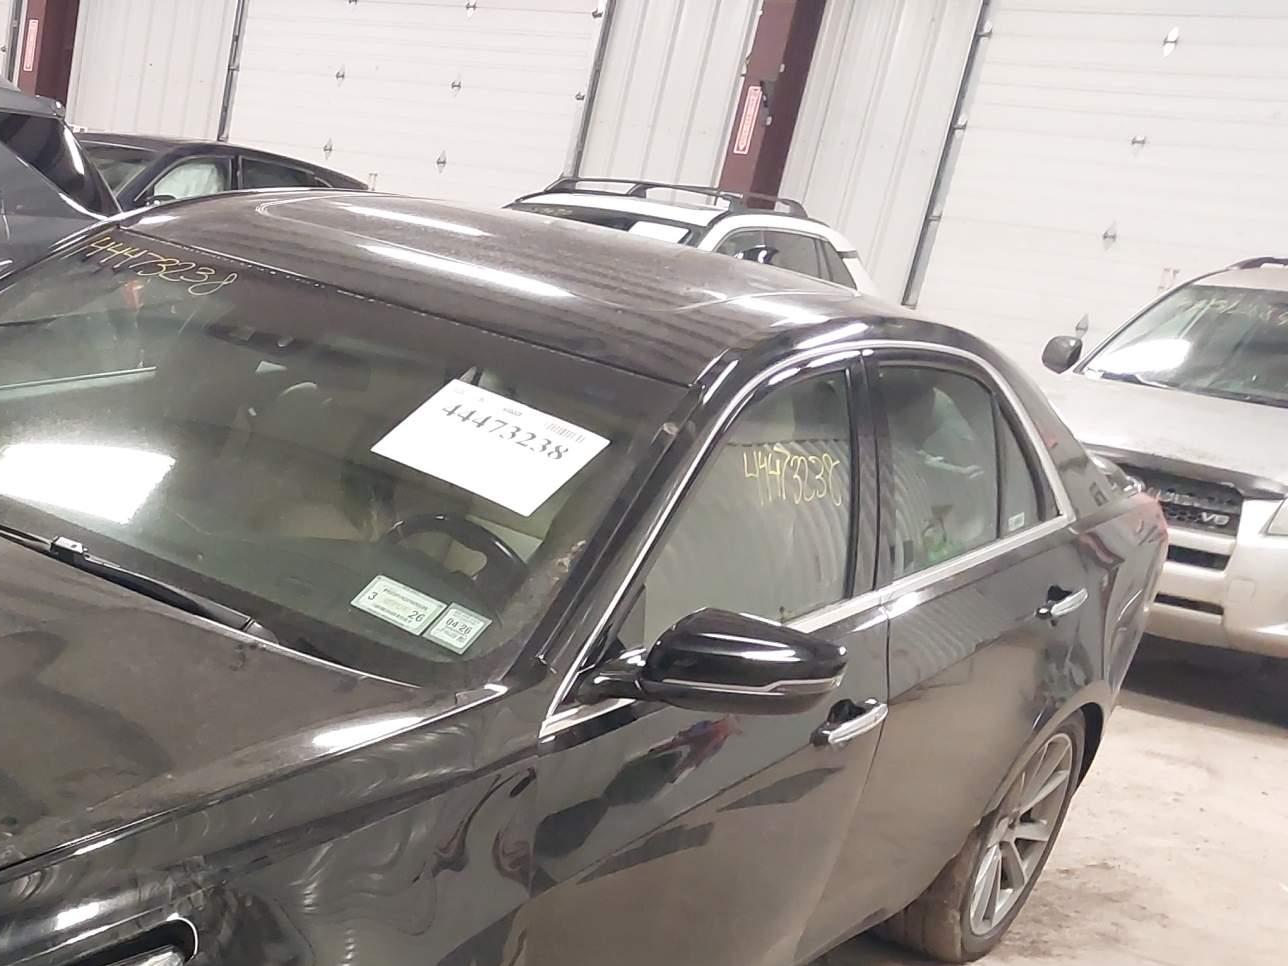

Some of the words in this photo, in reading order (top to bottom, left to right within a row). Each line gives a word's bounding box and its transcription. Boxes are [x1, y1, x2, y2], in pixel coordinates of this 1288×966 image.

[85, 236, 238, 296] 44473238
[442, 403, 569, 460] 44473238
[743, 442, 842, 506] 44473238
[1201, 512, 1230, 526] V6
[367, 591, 379, 601] 3
[407, 610, 426, 623] 26
